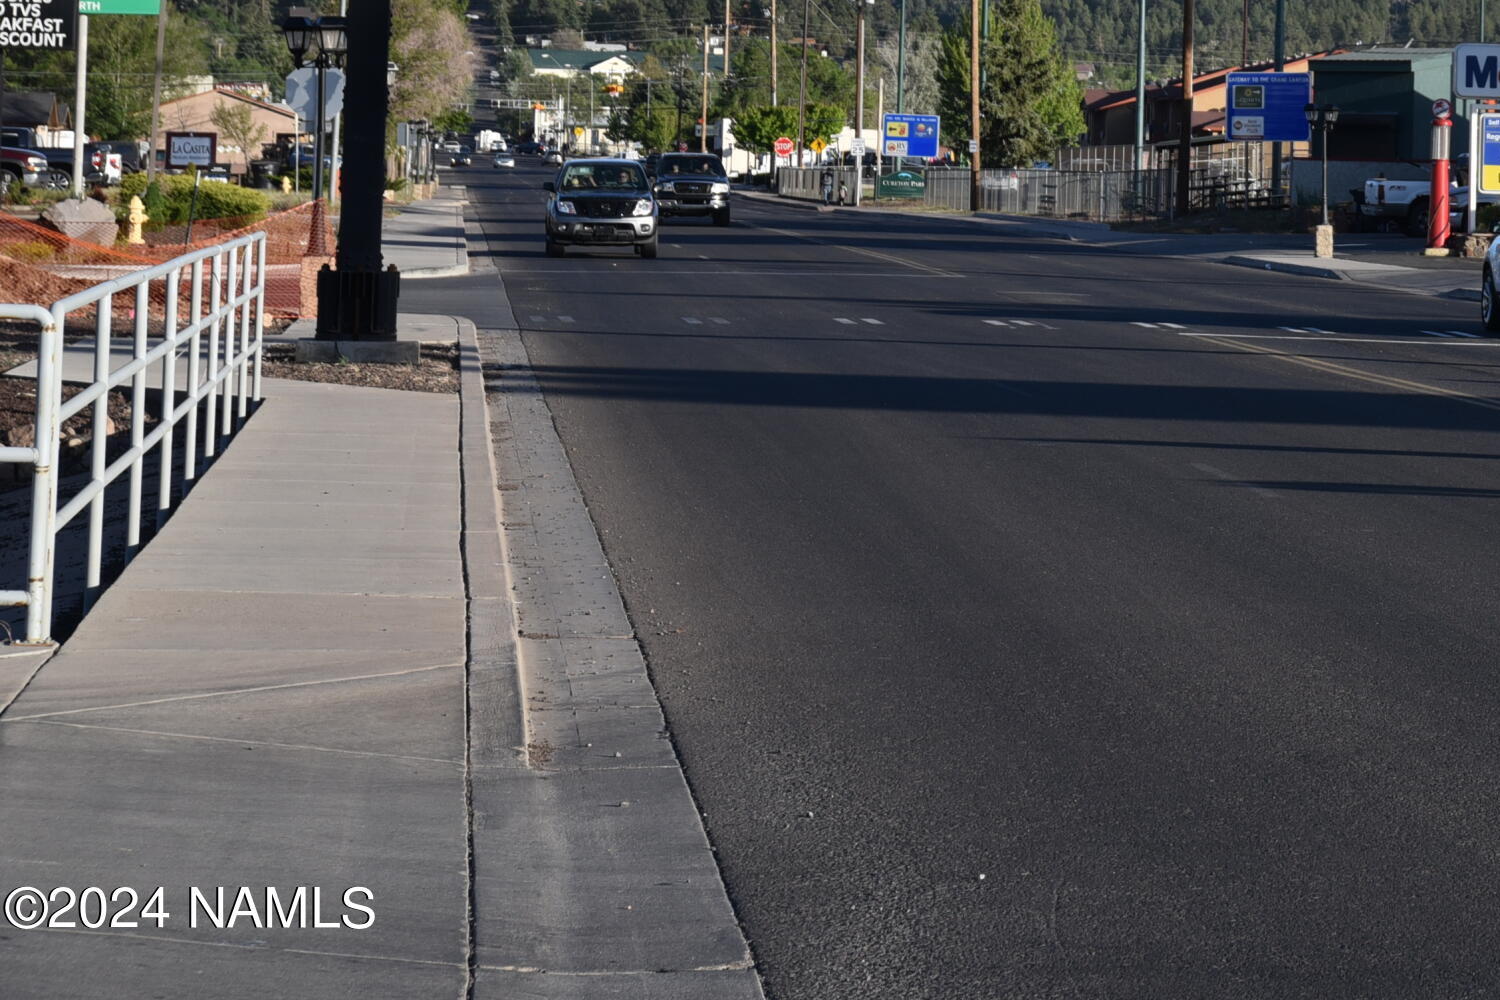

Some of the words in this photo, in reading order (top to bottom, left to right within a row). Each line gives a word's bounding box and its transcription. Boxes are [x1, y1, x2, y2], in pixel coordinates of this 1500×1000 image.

[10, 3, 42, 18] TVS
[775, 142, 792, 151] STOP
[852, 146, 864, 154] 25
